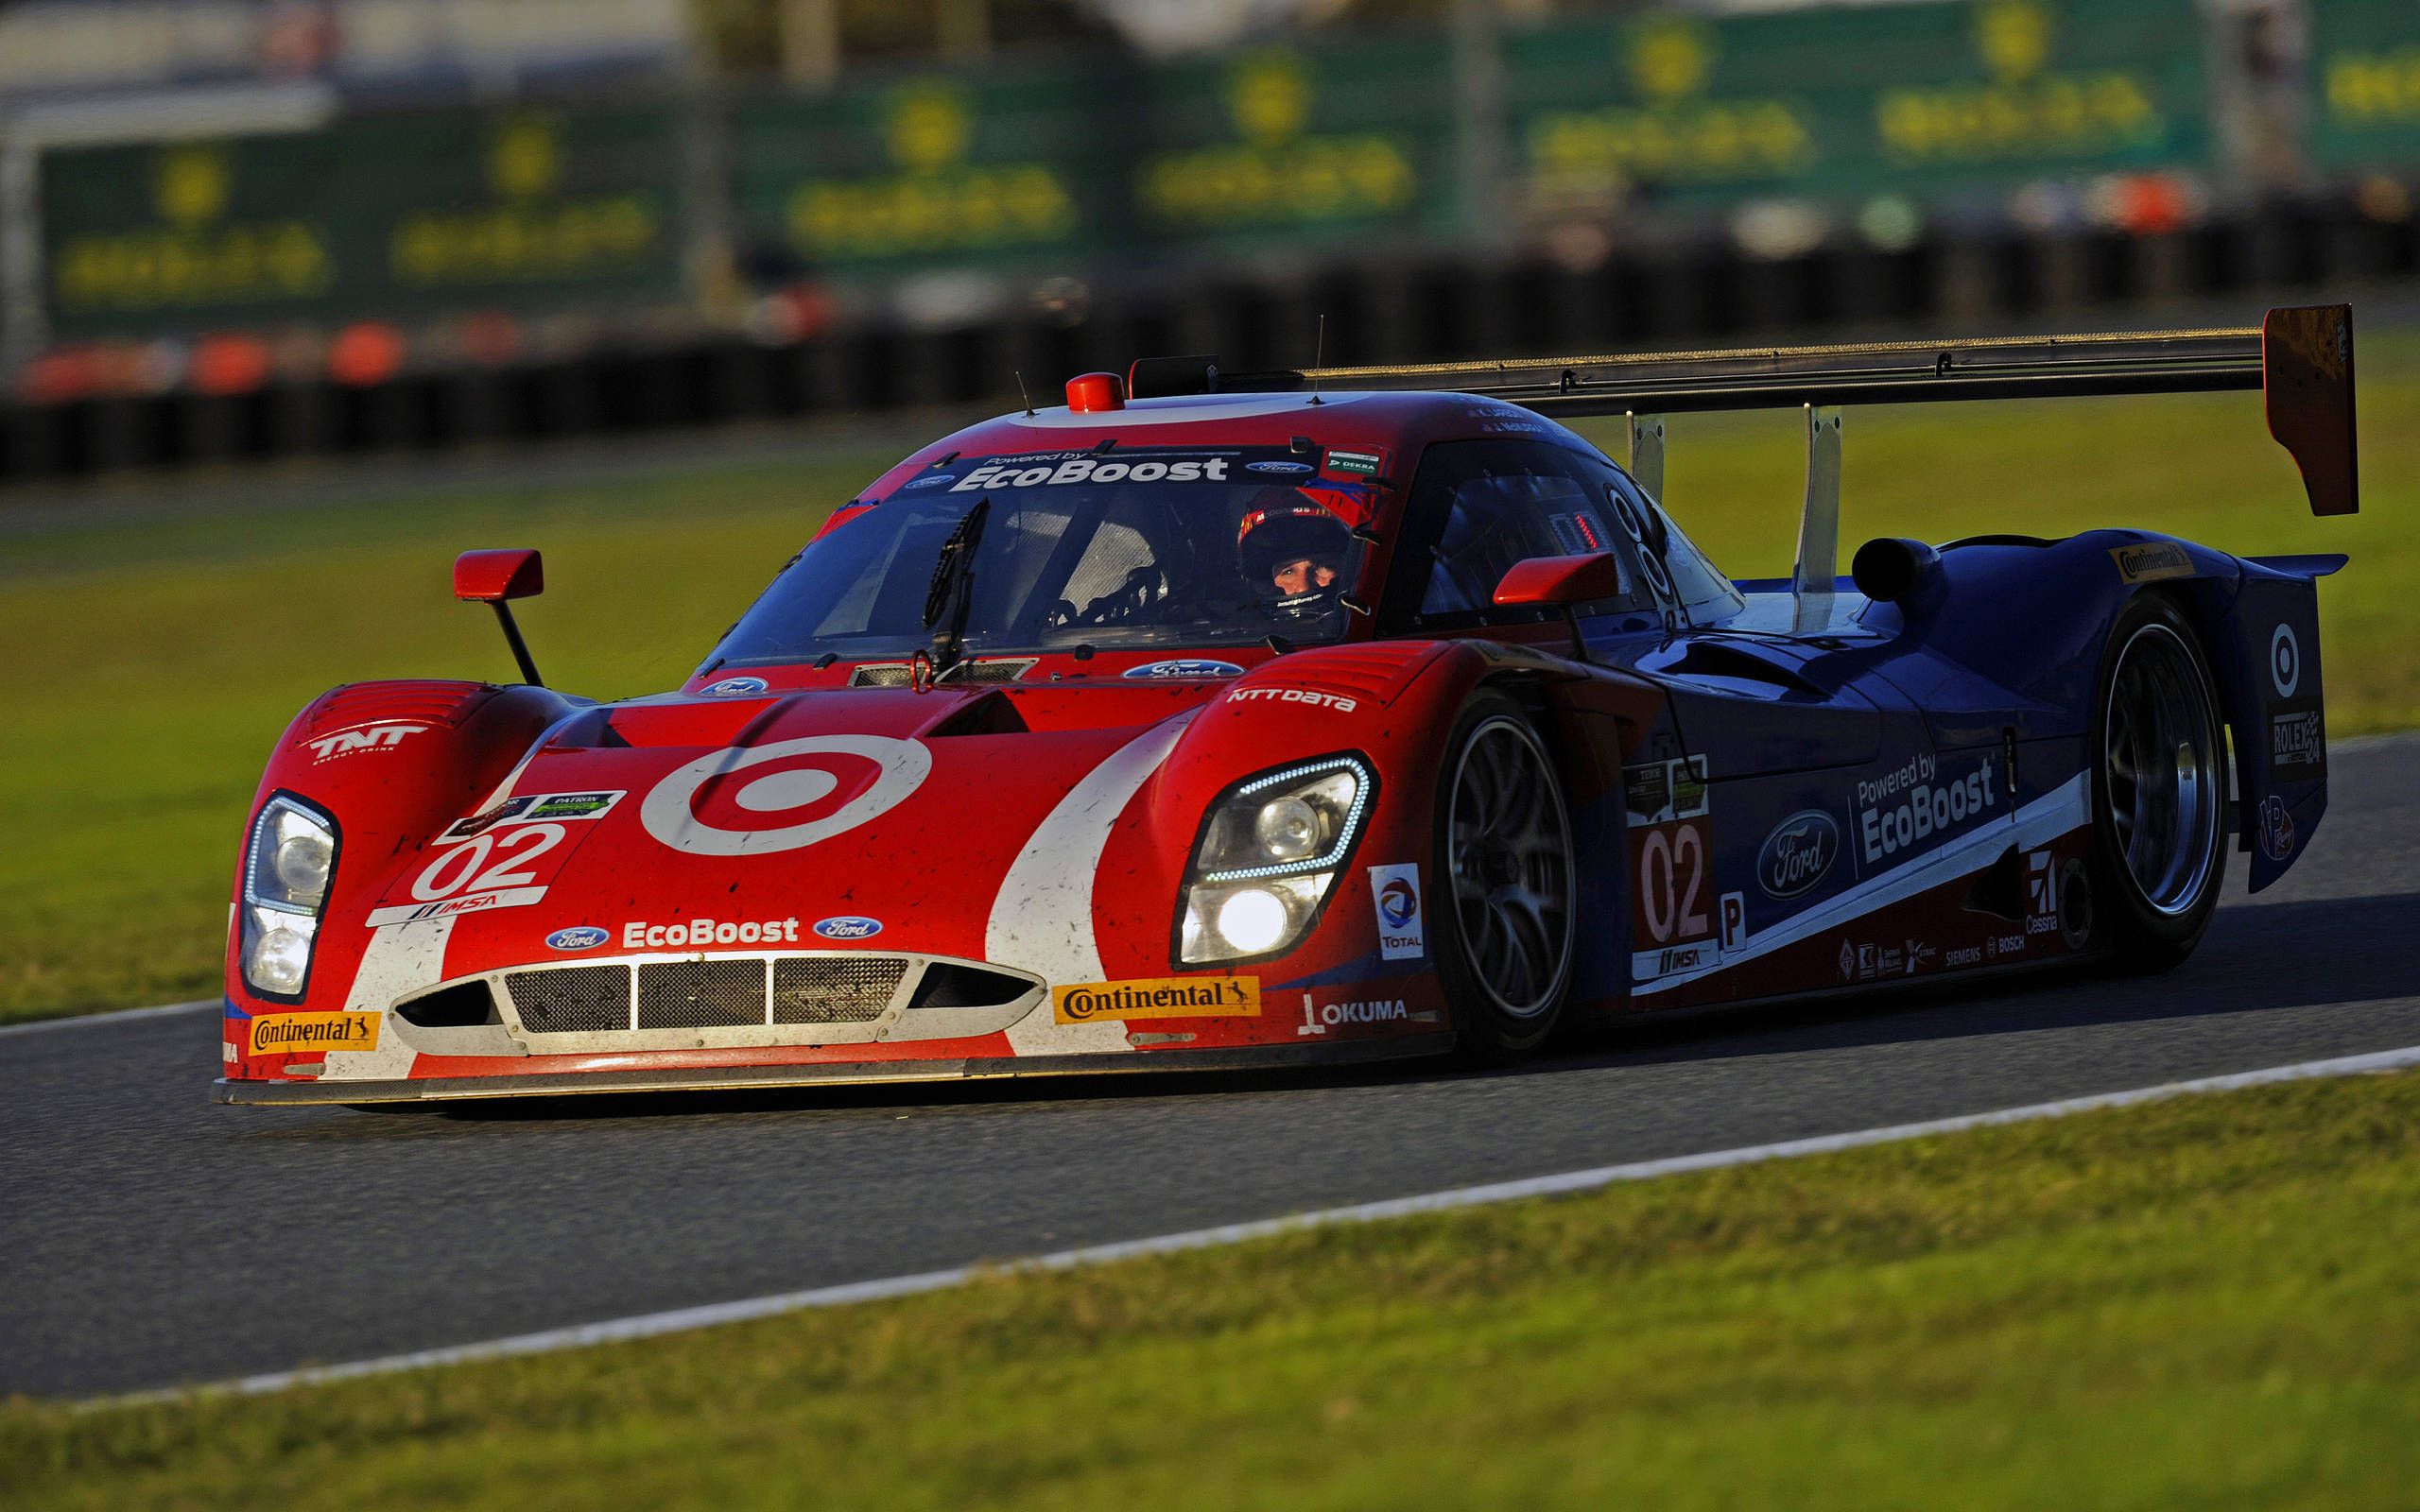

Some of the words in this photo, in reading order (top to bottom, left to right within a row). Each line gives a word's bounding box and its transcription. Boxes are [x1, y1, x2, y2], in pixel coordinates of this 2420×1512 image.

[985, 453, 1059, 465] Powered
[1061, 452, 1087, 460] by
[1342, 460, 1374, 470] DEKRA
[948, 457, 1228, 491] EcoBoost
[2119, 549, 2178, 578] Continental
[1226, 689, 1282, 703] NTT
[310, 726, 428, 758] TNT
[2274, 722, 2308, 752] ROLEX
[313, 751, 354, 765] ENERGY
[1858, 761, 1916, 808] Powered
[1919, 753, 1936, 781] by
[1861, 758, 1995, 864] EcoBoost
[411, 823, 566, 902] 02
[1774, 825, 1823, 888] Ford
[1641, 824, 1708, 942] 02
[438, 895, 497, 915] IMSA
[623, 917, 799, 948] EcoBoost
[827, 919, 868, 936] Ford
[1724, 899, 1740, 945] P
[2026, 915, 2057, 935] Cessna
[557, 929, 597, 947] Ford
[1382, 936, 1422, 948] TOTAL
[1998, 935, 2025, 954] BOSCH
[1672, 949, 1700, 970] IMSA
[1946, 947, 1980, 967] SIEMENS
[1063, 983, 1223, 1019] Continental
[1322, 999, 1408, 1024] OKUMA
[254, 1017, 352, 1051] Continental
